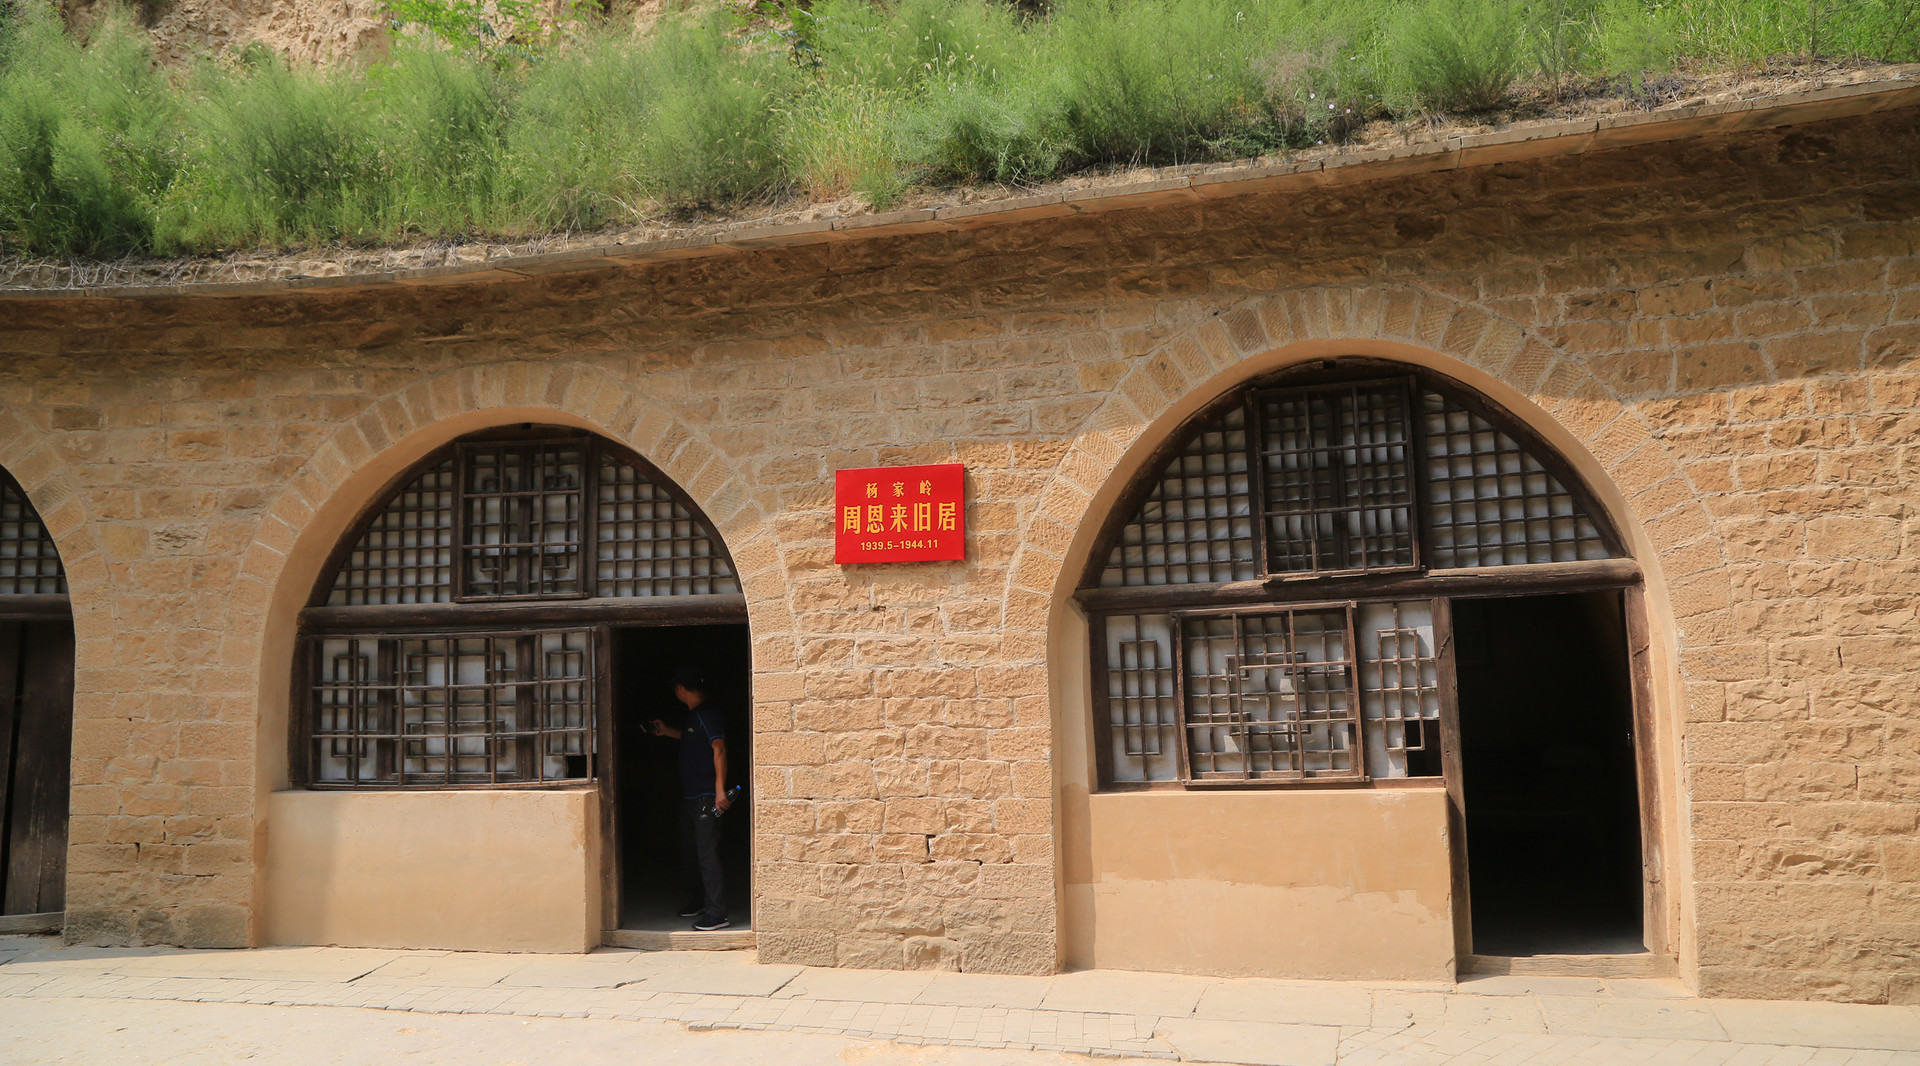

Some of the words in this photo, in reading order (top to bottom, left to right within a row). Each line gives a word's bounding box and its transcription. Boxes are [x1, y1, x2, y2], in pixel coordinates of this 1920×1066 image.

[866, 480, 932, 499] 杨家岭
[843, 502, 956, 534] 周恩来旧居
[861, 539, 938, 551] 1939.5-1944.11
